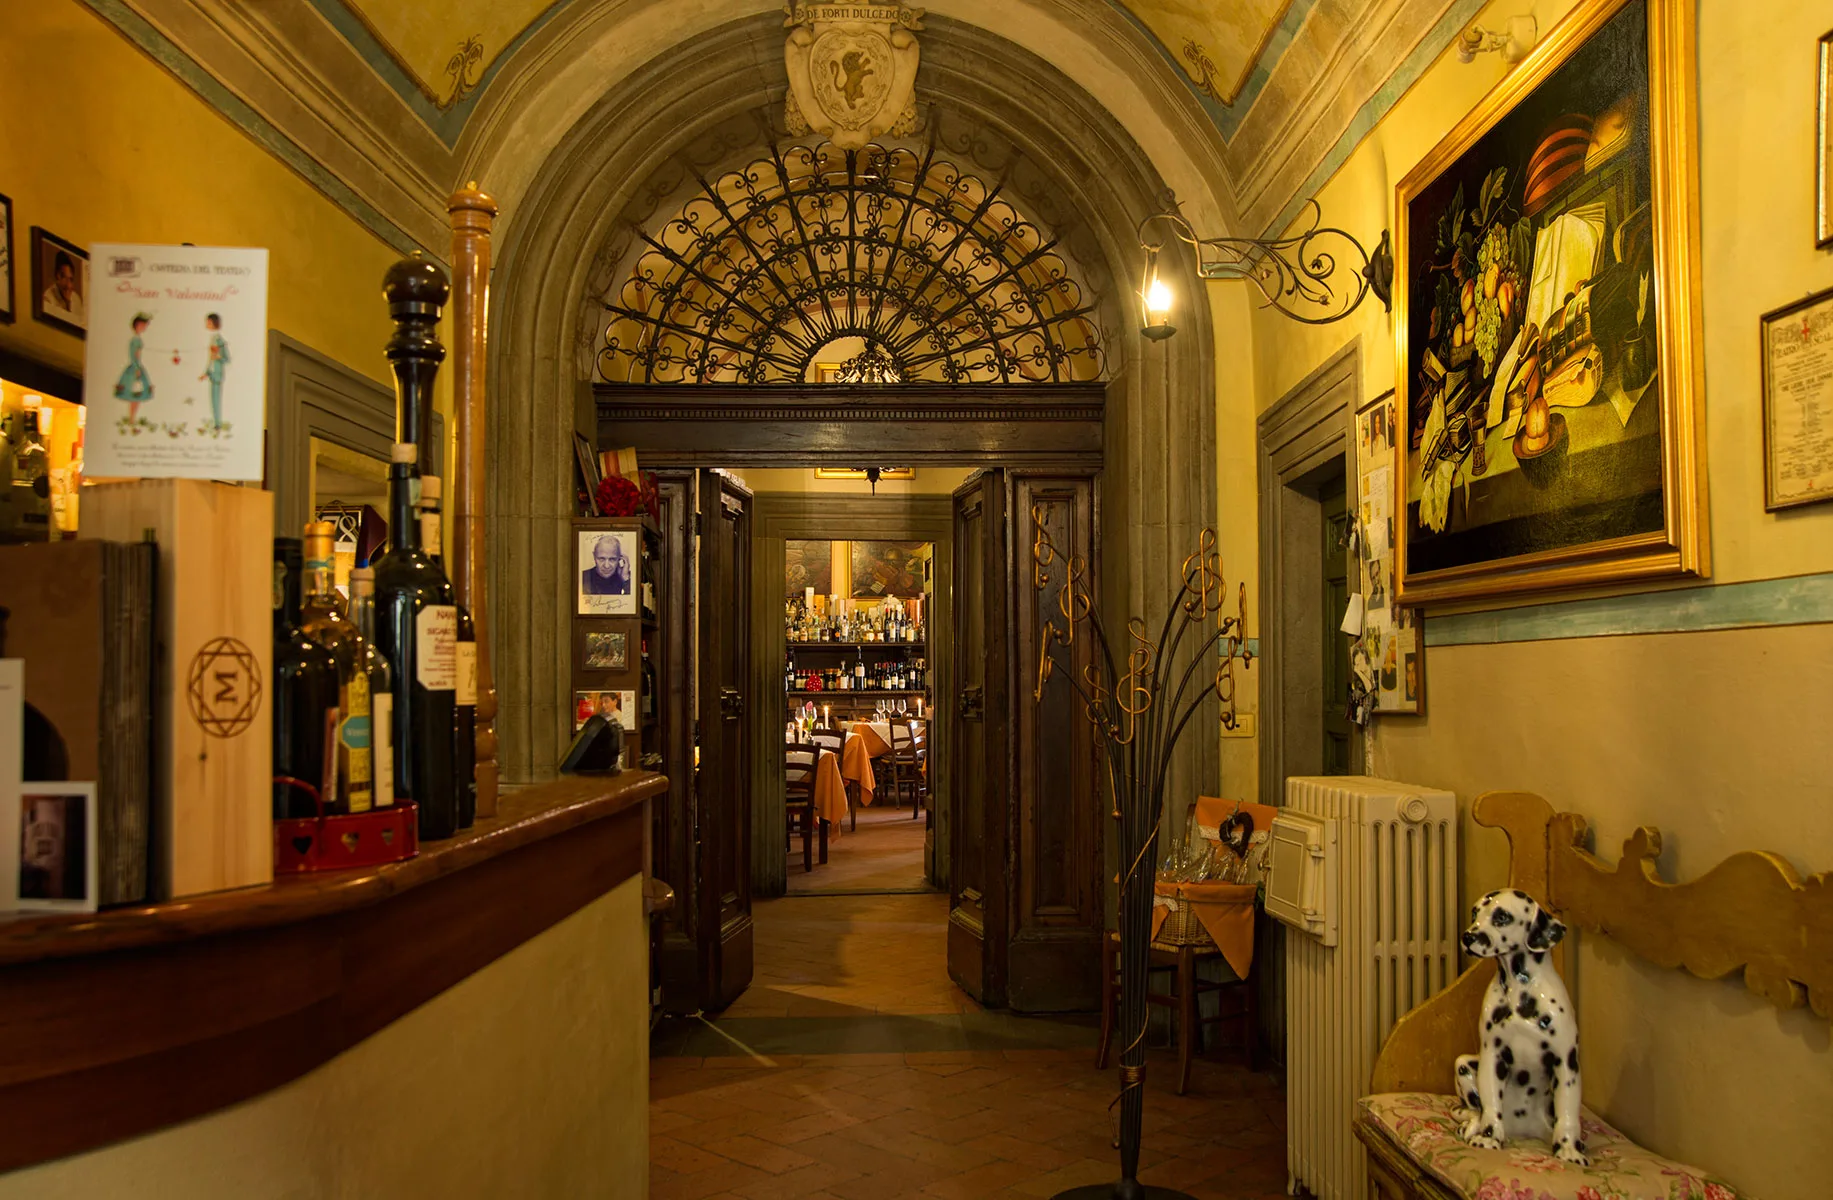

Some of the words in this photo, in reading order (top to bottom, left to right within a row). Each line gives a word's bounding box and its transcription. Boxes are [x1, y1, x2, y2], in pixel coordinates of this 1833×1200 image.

[808, 9, 819, 19] DE
[822, 8, 850, 18] FORTI
[853, 8, 899, 19] DULCEDO
[214, 670, 239, 706] M
